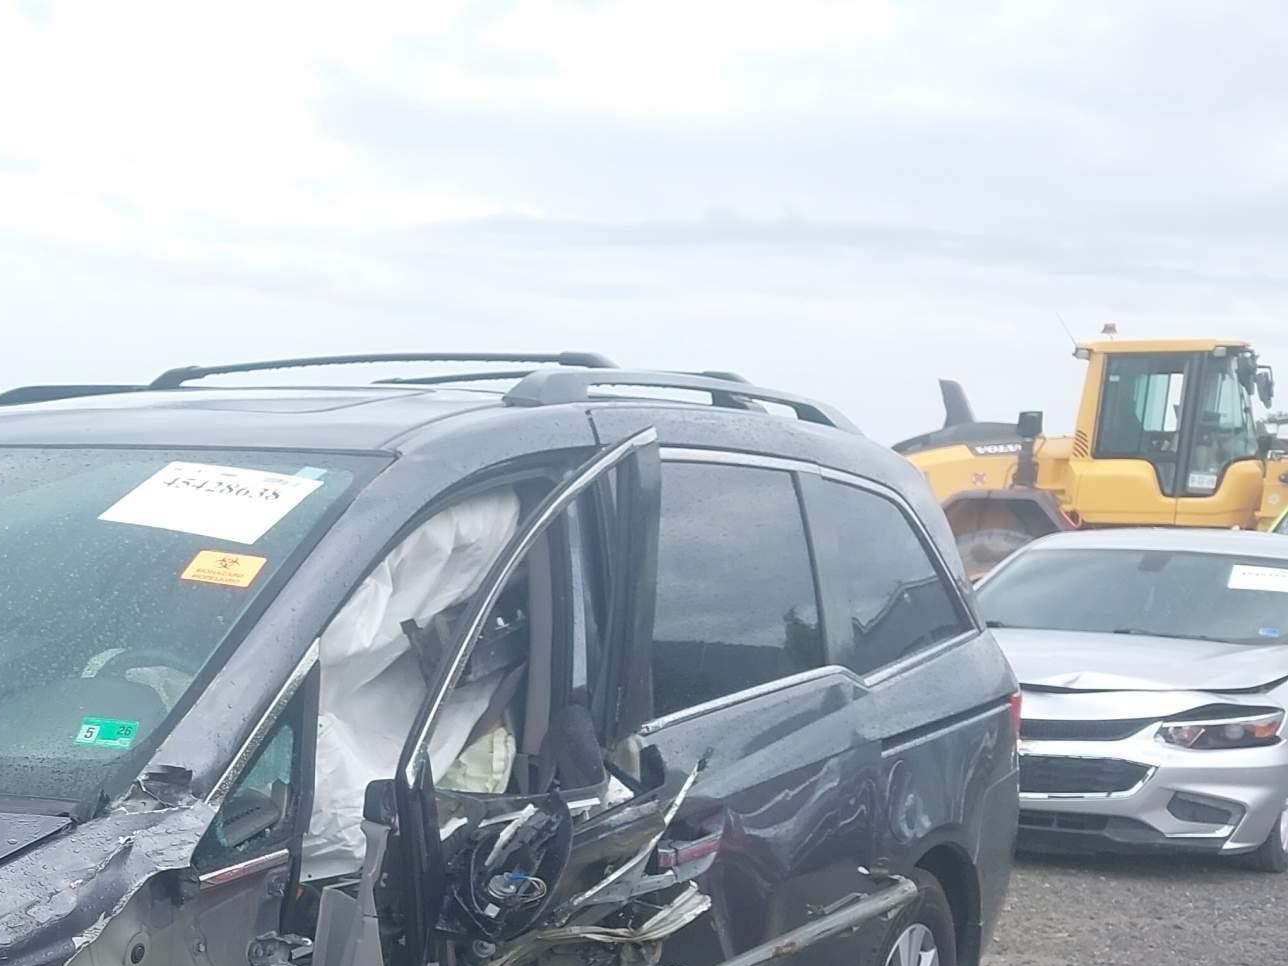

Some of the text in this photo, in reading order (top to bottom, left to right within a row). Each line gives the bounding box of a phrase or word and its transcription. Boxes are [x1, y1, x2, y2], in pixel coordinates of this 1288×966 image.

[162, 476, 281, 501] 45428638
[83, 726, 133, 739] 5 26
